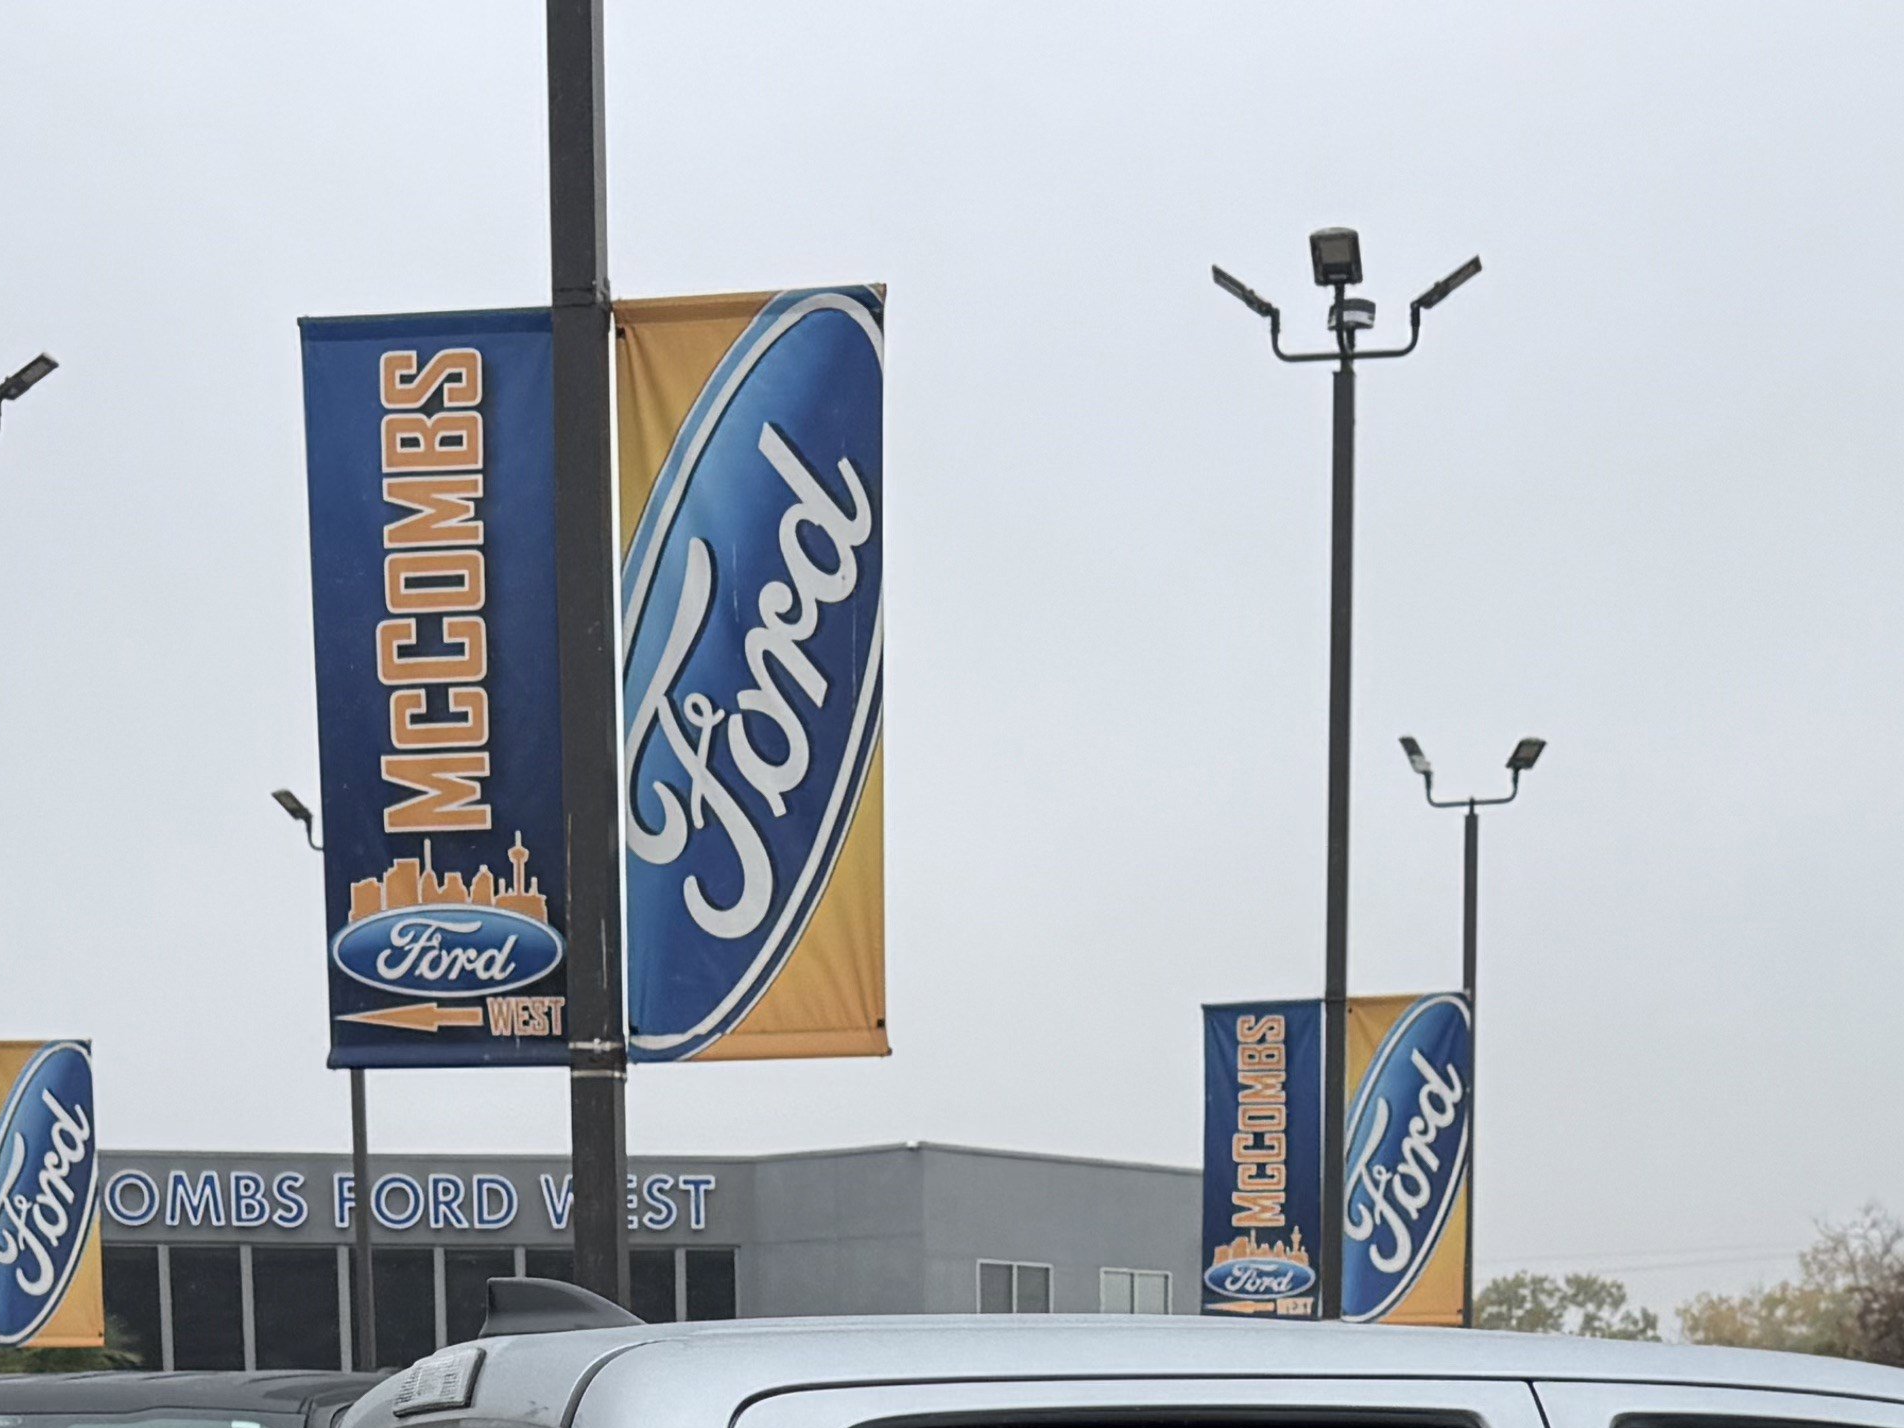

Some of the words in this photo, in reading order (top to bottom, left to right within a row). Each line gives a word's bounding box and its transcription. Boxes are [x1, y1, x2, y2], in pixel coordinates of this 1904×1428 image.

[375, 347, 492, 833] MCCOMBS
[625, 421, 872, 940] Ford
[376, 916, 517, 981] Ford
[487, 996, 566, 1036] WEST
[1232, 1014, 1286, 1228] MCCOMBS
[1346, 1047, 1463, 1274] Ford
[104, 1168, 308, 1230] OMBS
[334, 1173, 519, 1230] FORD
[1224, 1263, 1295, 1293] Ford
